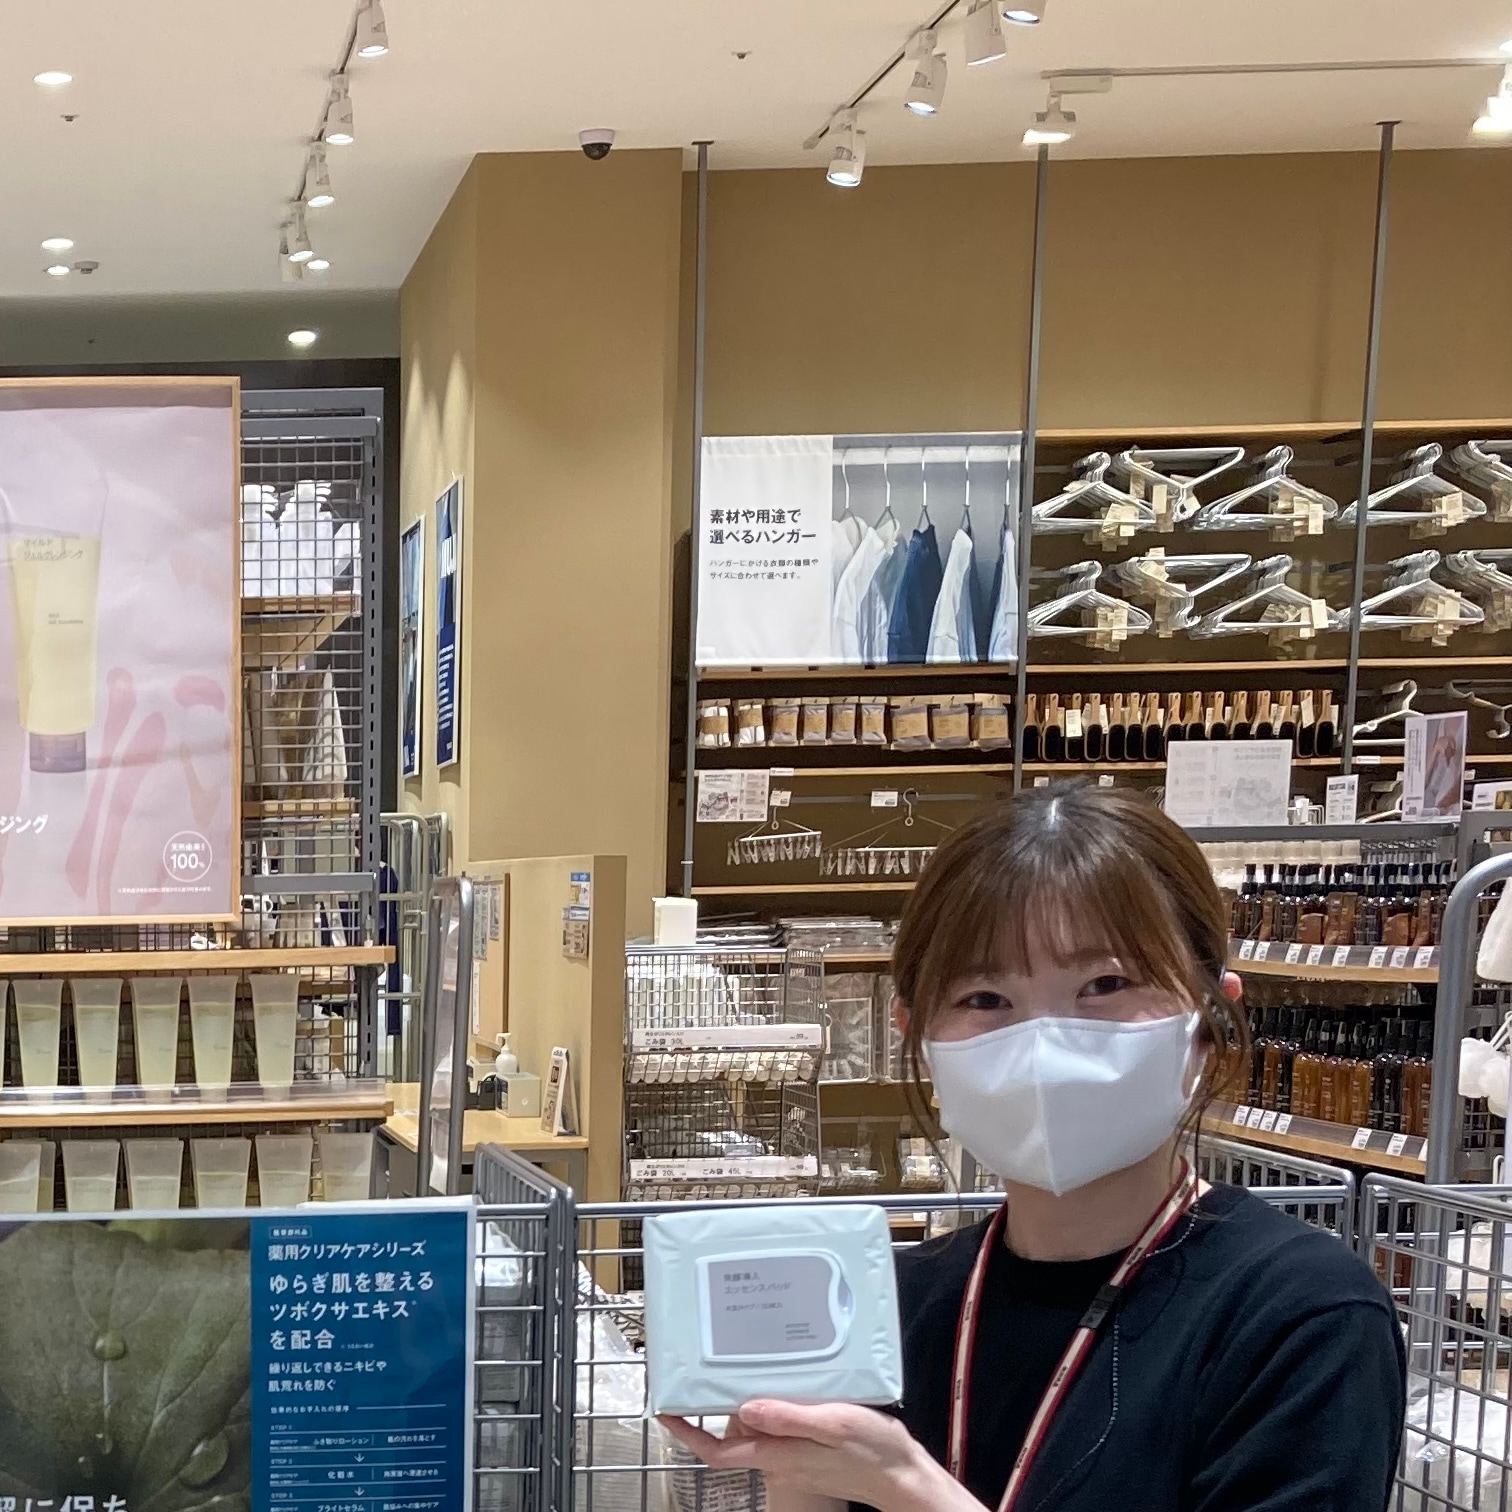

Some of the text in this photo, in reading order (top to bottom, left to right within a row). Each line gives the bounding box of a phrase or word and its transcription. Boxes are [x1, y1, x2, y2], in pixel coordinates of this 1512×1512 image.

[710, 508, 802, 525] 素材や用途で
[710, 528, 817, 545] 選べるハンガー
[268, 1240, 427, 1261] 薬用クリアケアシリーズ
[269, 1271, 434, 1295] ゆらぎ肌を整える
[270, 1328, 335, 1350] を配合
[268, 1360, 387, 1374] 繰り返しできるニキビや
[268, 1379, 336, 1392] 肌荒れを防ぐ
